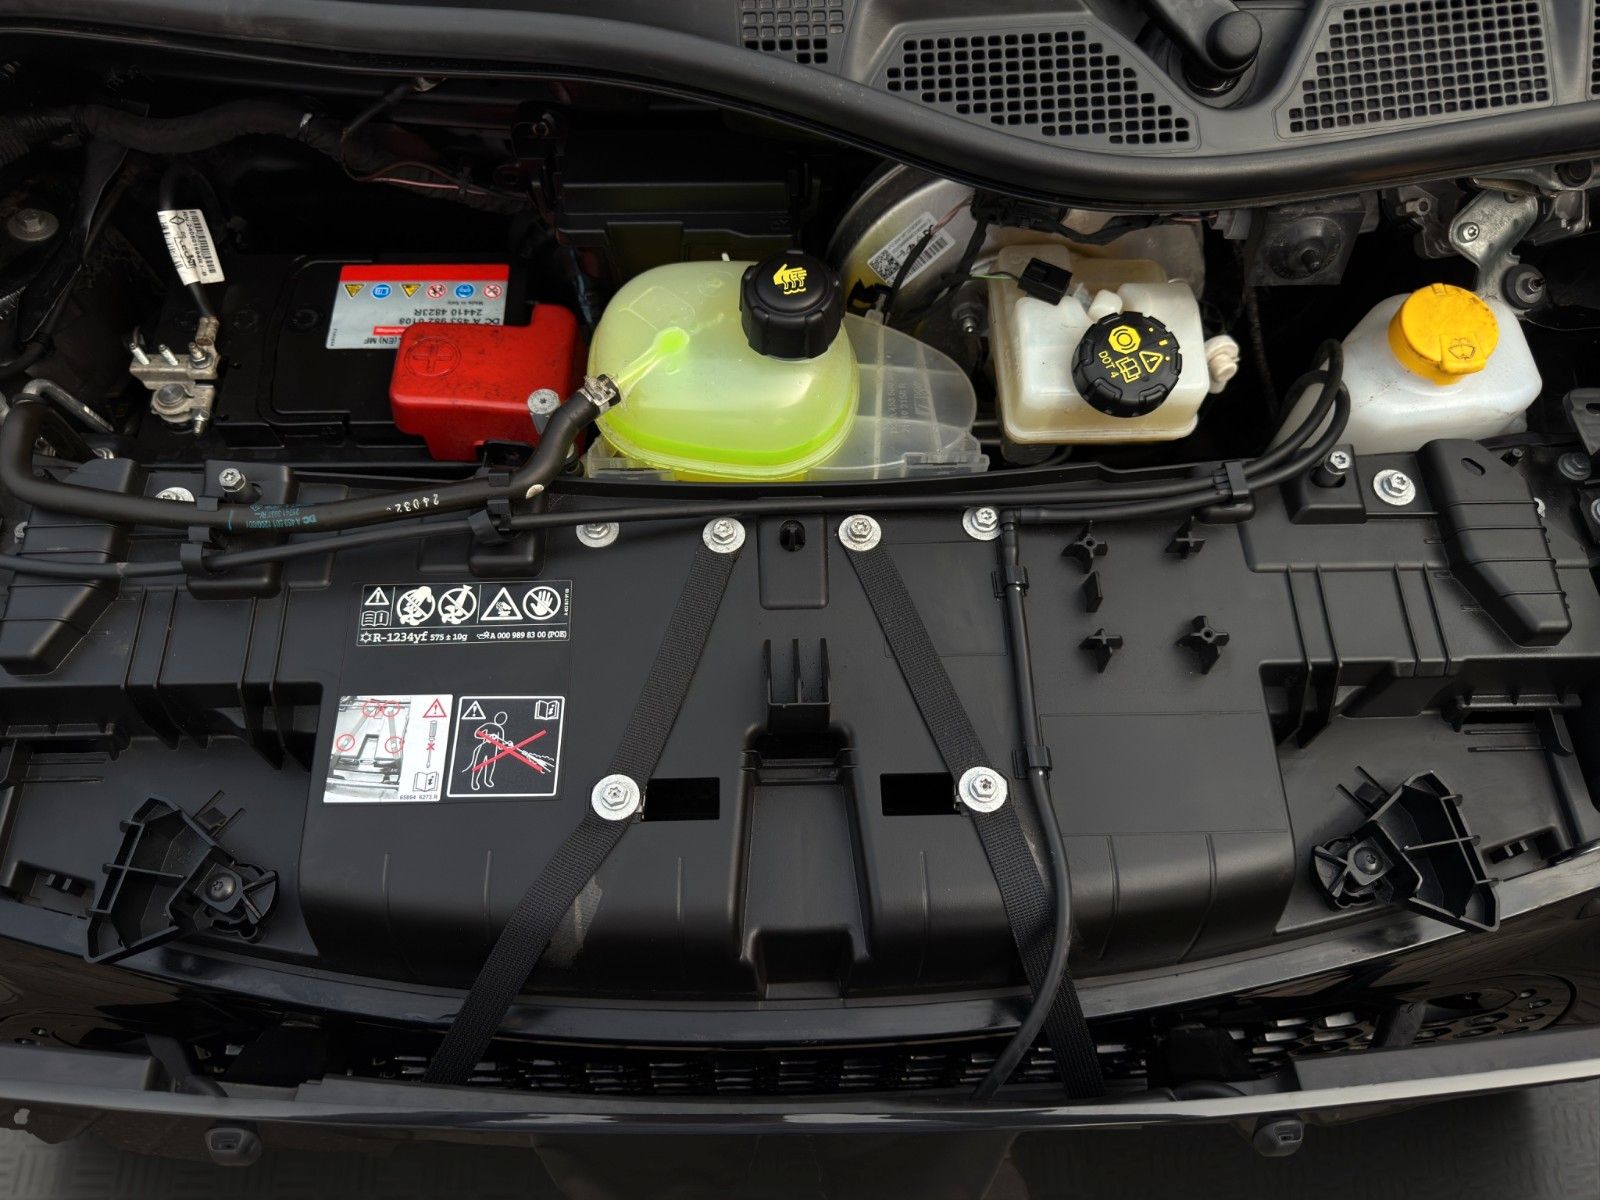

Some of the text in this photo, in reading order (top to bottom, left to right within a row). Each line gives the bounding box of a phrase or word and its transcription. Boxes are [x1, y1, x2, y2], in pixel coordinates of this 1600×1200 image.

[414, 308, 482, 317] 24410 4823R
[363, 336, 397, 345] (EN) MF
[1098, 350, 1116, 369] DOT
[302, 514, 318, 524] DC
[373, 630, 428, 644] R-1234yf
[453, 633, 468, 642] 10g
[512, 631, 525, 639] 989
[526, 631, 535, 639] 83
